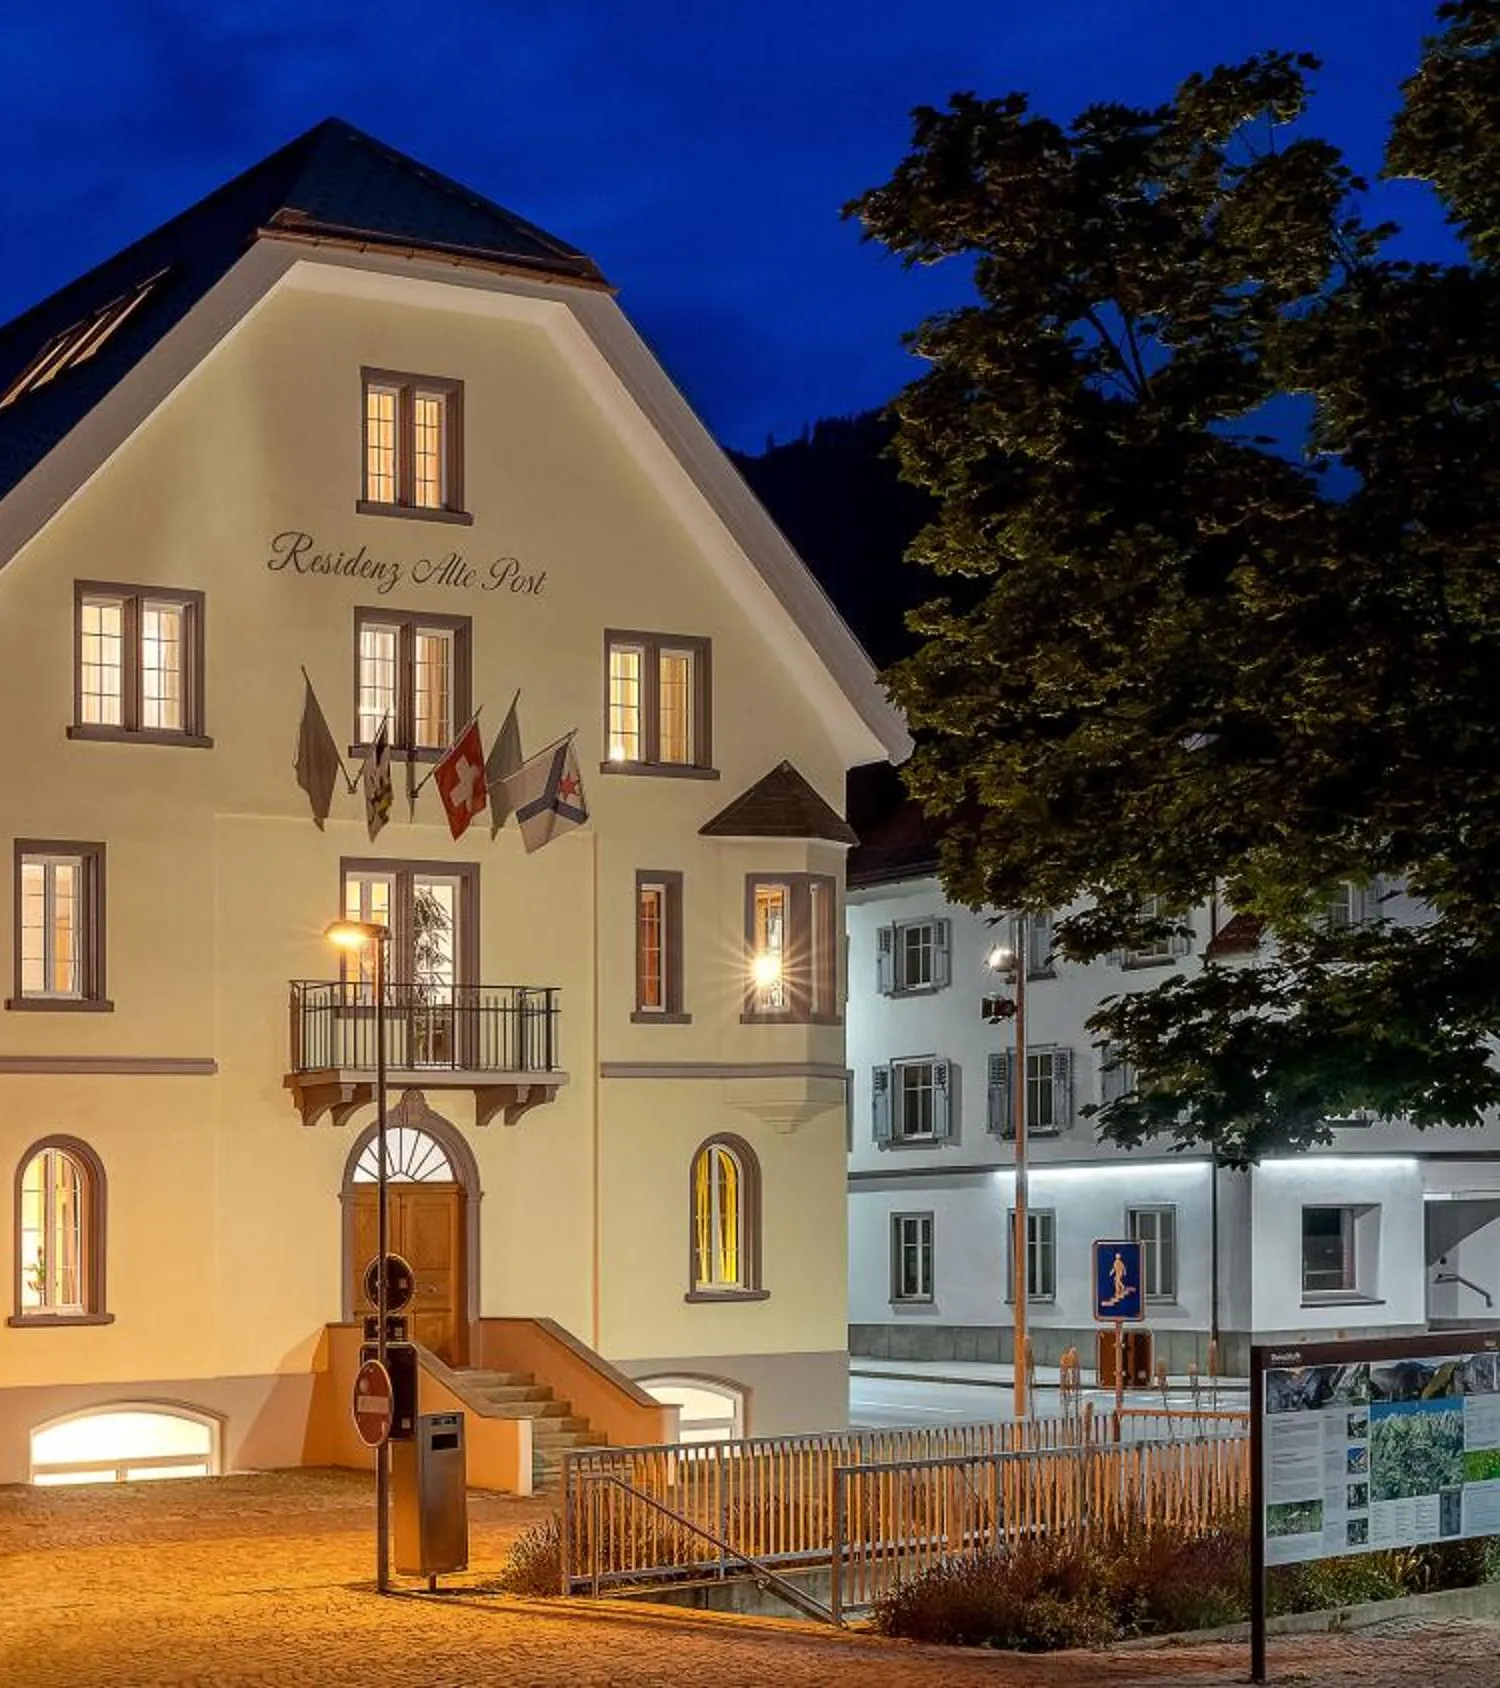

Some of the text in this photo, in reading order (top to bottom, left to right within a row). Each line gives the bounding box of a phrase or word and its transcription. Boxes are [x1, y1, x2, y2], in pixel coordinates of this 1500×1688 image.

[267, 530, 550, 596] Residenz Alte Post
